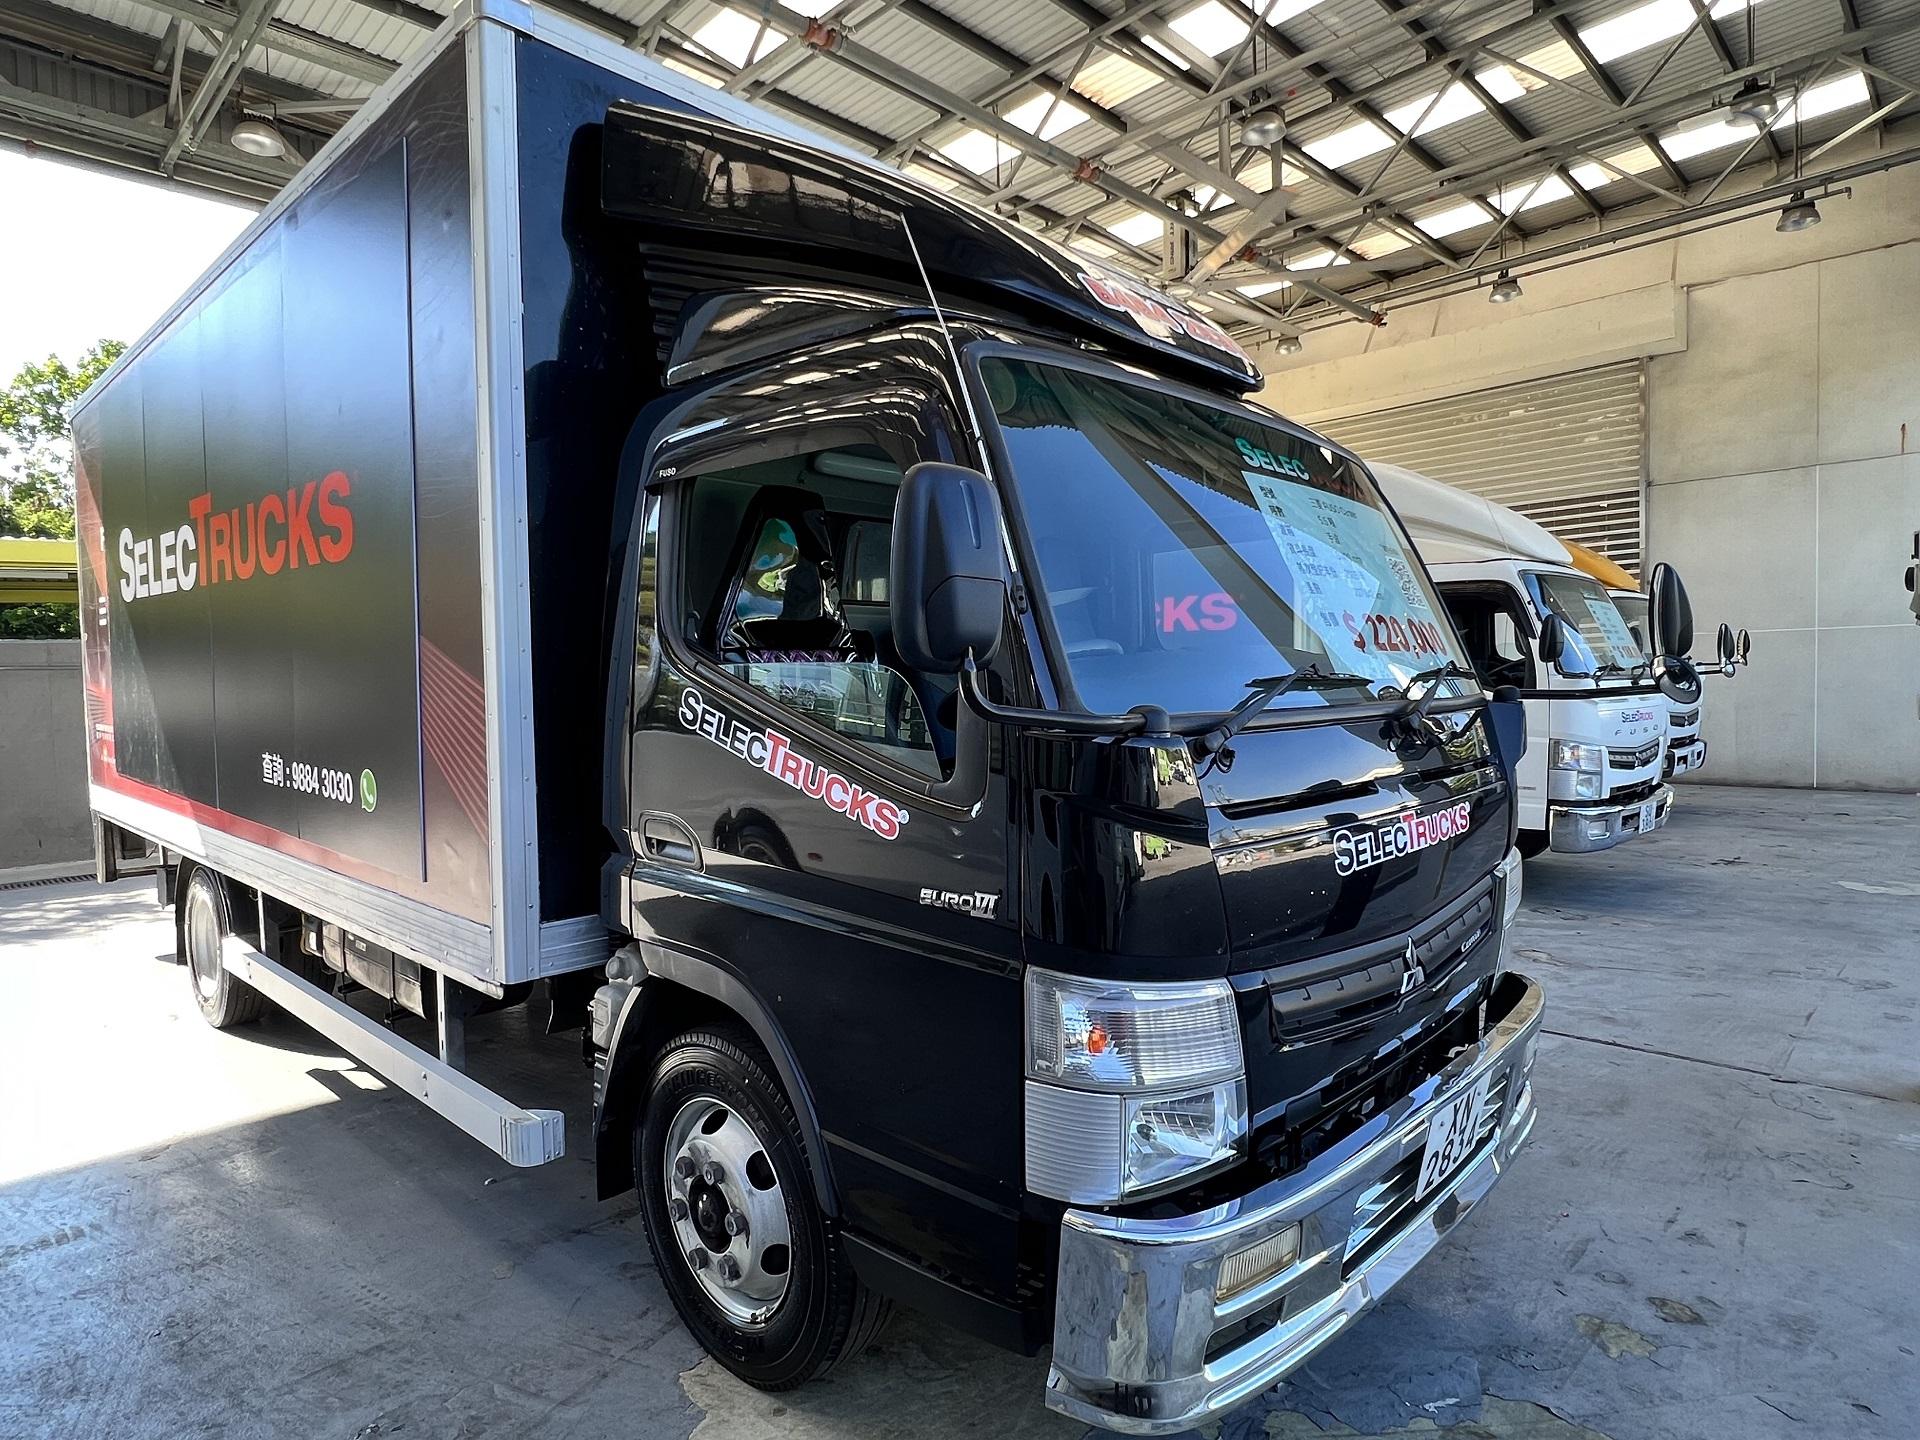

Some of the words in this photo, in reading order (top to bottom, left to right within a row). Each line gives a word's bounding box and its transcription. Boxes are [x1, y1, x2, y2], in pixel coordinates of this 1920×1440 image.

[659, 467, 677, 478] FUSO
[1155, 592, 1238, 633] KS
[292, 761, 320, 794] 9884
[321, 768, 354, 804] 3030
[1446, 1086, 1478, 1142] XN
[1421, 1113, 1479, 1195] 2834
